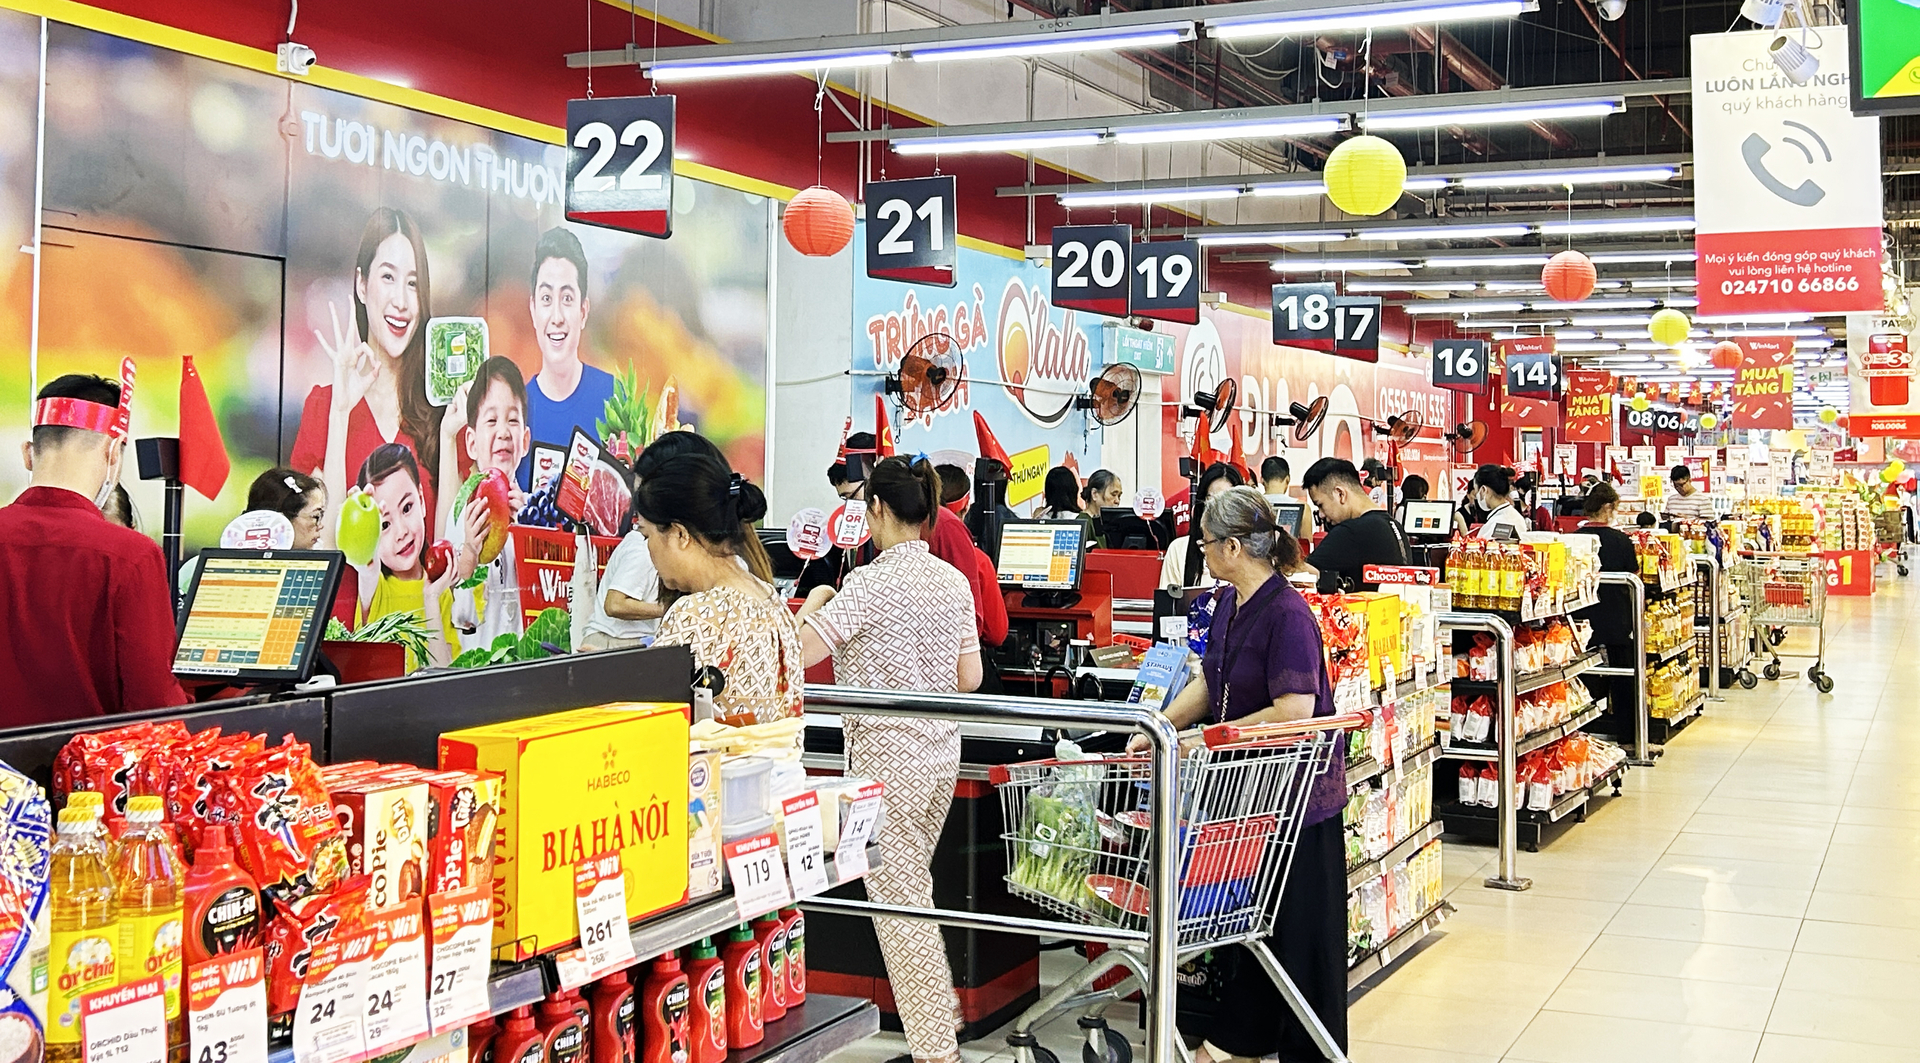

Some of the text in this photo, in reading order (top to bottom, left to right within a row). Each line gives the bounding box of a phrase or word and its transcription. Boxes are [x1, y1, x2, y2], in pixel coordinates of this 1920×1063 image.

[1706, 76, 1754, 93] LUÔN
[1722, 94, 1848, 115] quý khách hàng
[384, 129, 471, 186] NGON
[573, 120, 664, 193] 22
[876, 195, 944, 255] 21
[1057, 239, 1125, 288] 20
[1705, 248, 1876, 265] Mọi ý kiến đóng góp quý khách
[1136, 254, 1193, 299] 19
[1729, 262, 1852, 277] vui lòng liên hệ hotline
[1721, 277, 1859, 295] 024710 66866
[954, 287, 986, 350] GÀ
[1278, 294, 1330, 331] 18
[1335, 307, 1374, 341] 17
[1514, 343, 1543, 351] WinMart
[1750, 342, 1780, 350] WinMart
[1437, 348, 1479, 377] 16
[1888, 351, 1903, 366] 3
[1511, 361, 1548, 386] 14
[1741, 368, 1779, 381] MUA
[1778, 364, 1794, 394] 1
[1572, 395, 1599, 406] MUA
[1735, 382, 1779, 397] TẶNG
[1380, 386, 1445, 426] 0559 701 535
[1567, 406, 1600, 418] TẶNG
[1600, 393, 1611, 415] 1
[1628, 411, 1653, 427] 08
[1657, 414, 1679, 430] 06
[1012, 462, 1047, 486] THỬ NGAY!
[1365, 570, 1413, 582] ChocoPie
[1839, 555, 1853, 585] 1
[587, 769, 631, 792] HABECO
[542, 793, 670, 873] BIA HÀ NỘI
[852, 818, 865, 836] 14
[743, 858, 771, 887] 119
[801, 854, 813, 872] 12
[207, 895, 257, 925] CHIN-SU
[586, 919, 613, 946] 261
[591, 953, 606, 966] 268
[58, 956, 116, 992] Orchid
[433, 970, 457, 996] 27
[89, 981, 158, 1012] KHUYẾN MẠI
[367, 989, 394, 1017] 24
[310, 998, 336, 1025] 24
[90, 1034, 122, 1051] ORCHID
[369, 1027, 382, 1040] 29
[90, 1051, 104, 1063] Vật
[198, 1040, 228, 1063] 43
